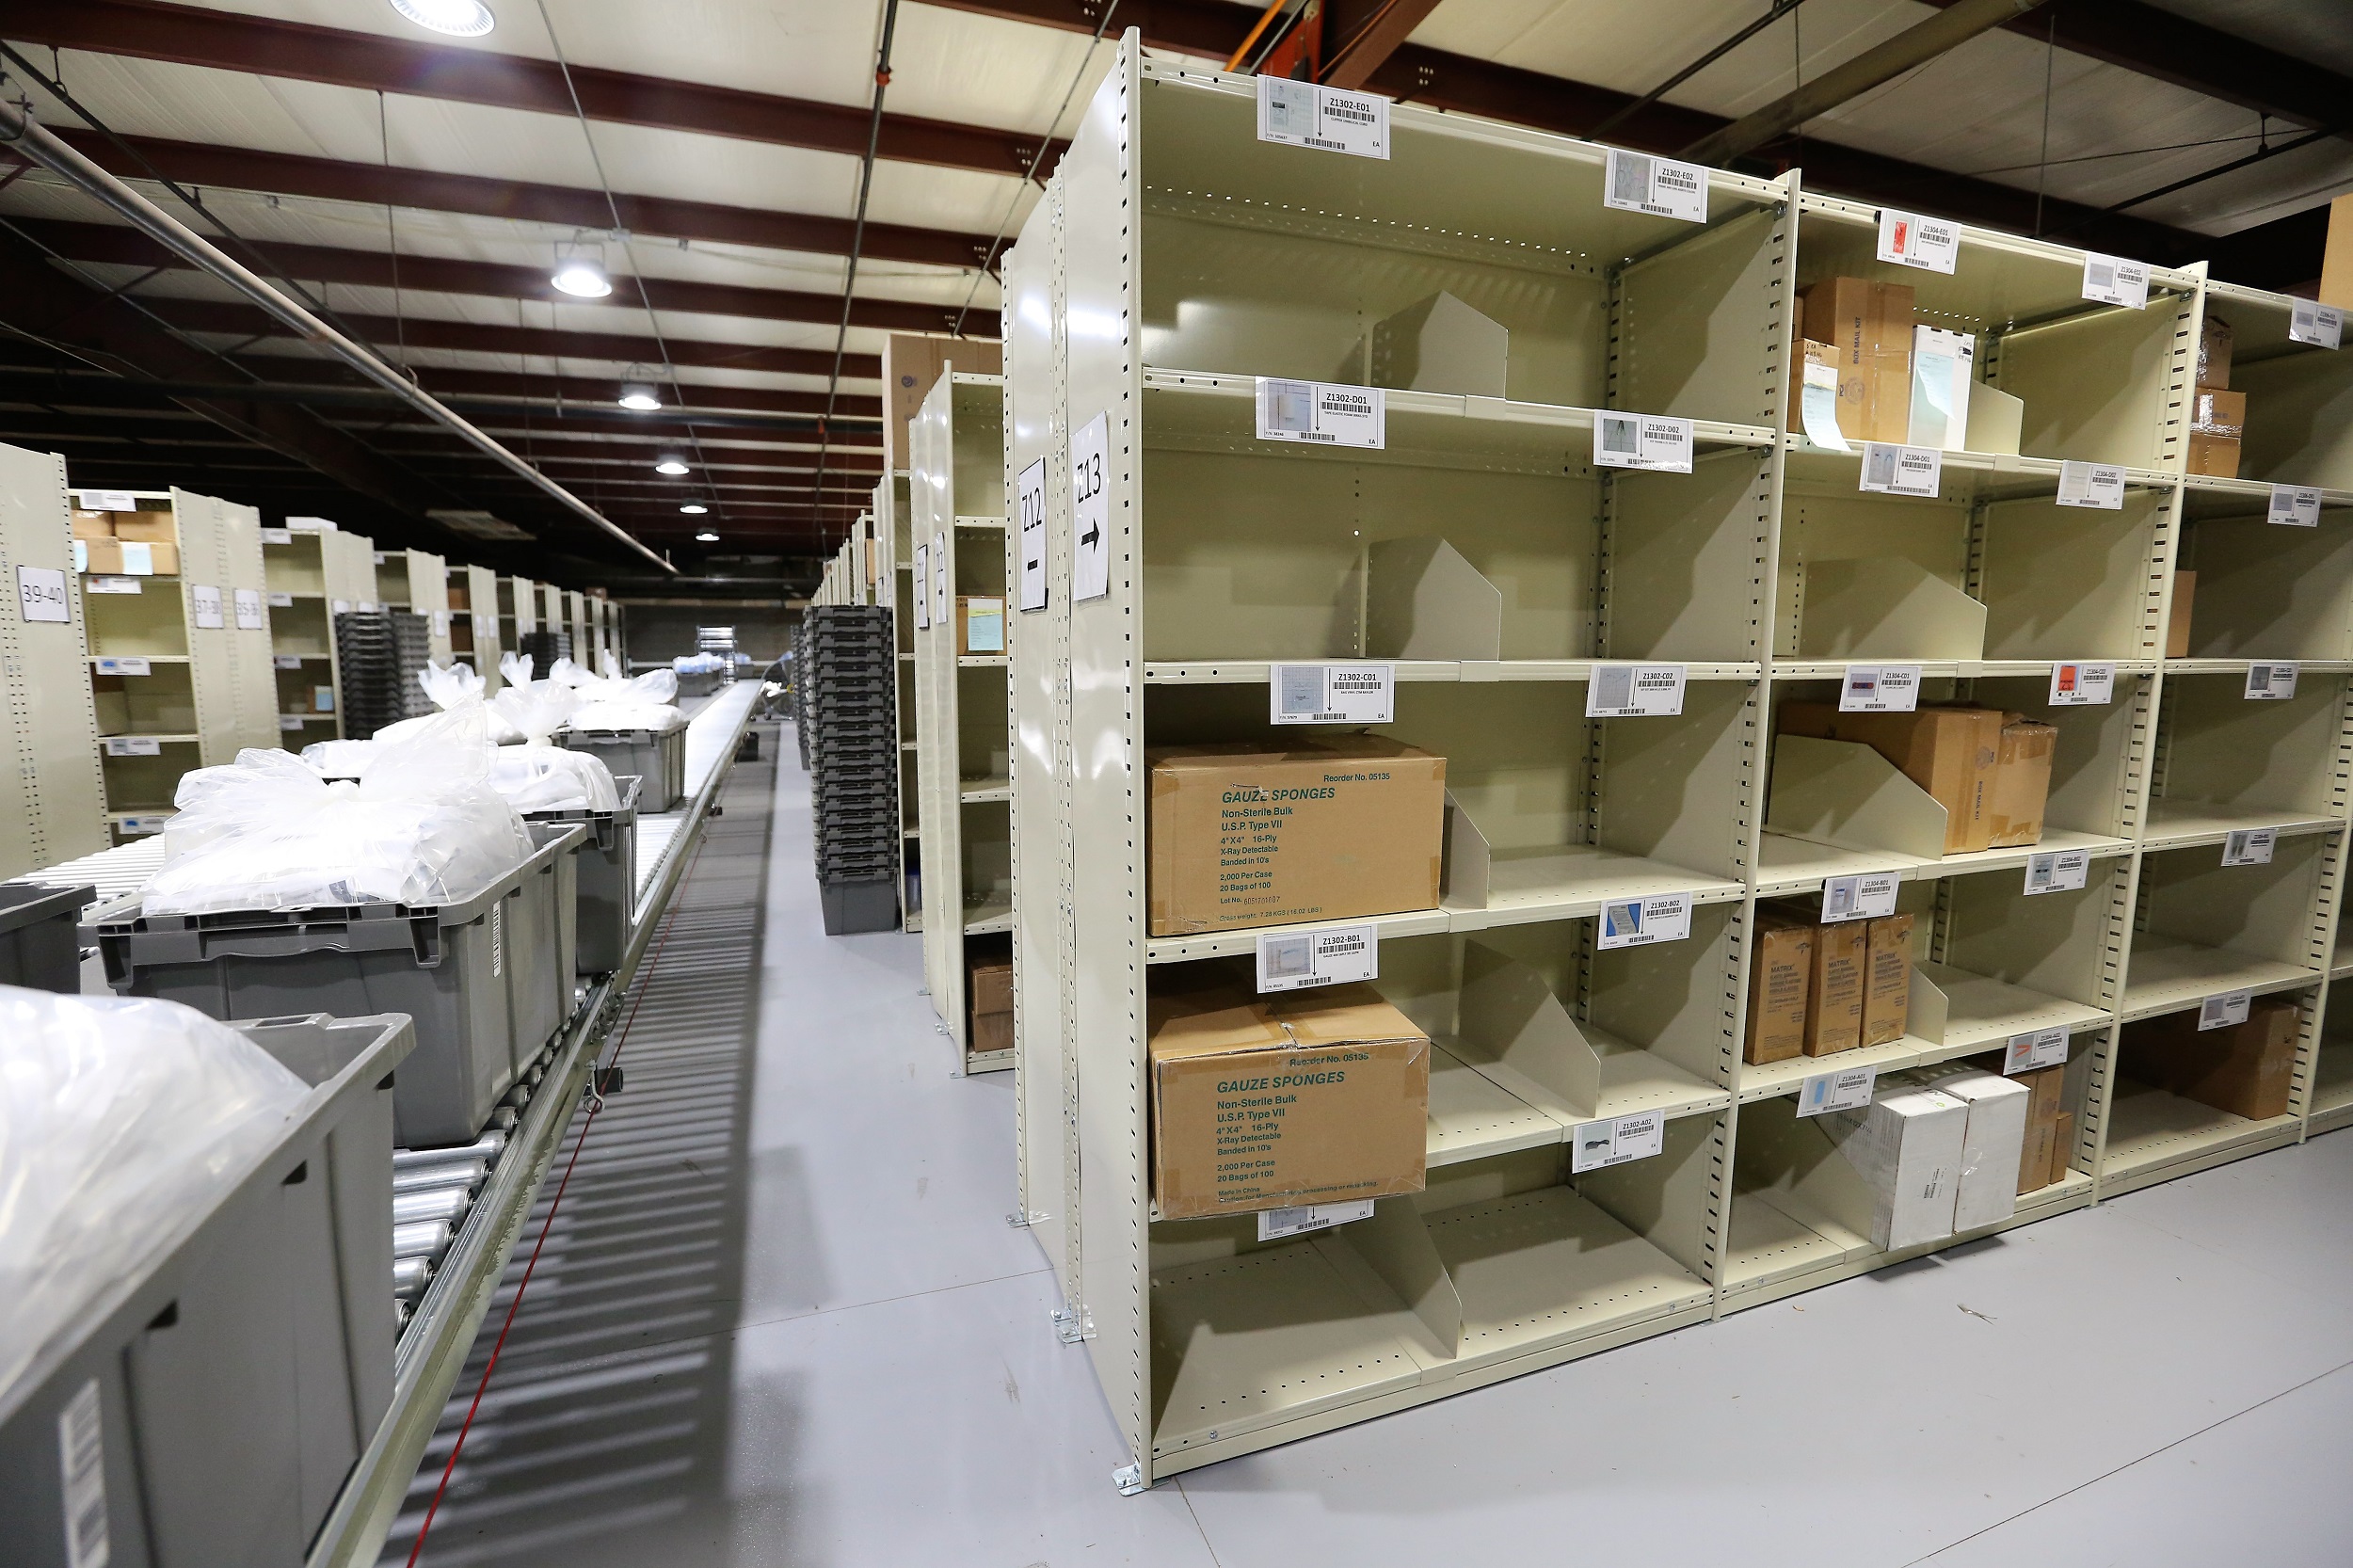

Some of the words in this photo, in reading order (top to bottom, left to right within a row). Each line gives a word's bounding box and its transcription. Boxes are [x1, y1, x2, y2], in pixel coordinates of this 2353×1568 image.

[1329, 98, 1370, 113] Z1302-E01
[1662, 168, 1694, 181] Z1302-E02
[1327, 393, 1368, 405] Z1302-D01
[1648, 424, 1679, 433] Z1302-D02
[1077, 452, 1101, 504] Z13
[1021, 487, 1043, 533] Z12
[23, 584, 64, 604] 39-40
[1323, 774, 1353, 783] Reorder
[1369, 773, 1390, 781] 05135
[1271, 787, 1335, 800] SPONGES
[1222, 808, 1272, 819] Non-Sterile
[1273, 806, 1293, 816] Bulk
[1222, 822, 1246, 832] U.S.P.
[1248, 821, 1269, 831] Type
[1271, 820, 1282, 828] VII
[1253, 835, 1277, 843] 16-Ply
[1221, 847, 1241, 856] X-Ray
[1242, 845, 1278, 854] Detectable
[1221, 857, 1247, 866] Banded
[1230, 884, 1248, 892] Bags
[1651, 900, 1679, 909] Z1302-B02
[1323, 934, 1361, 945] Z1302-B01
[1289, 1056, 1325, 1066] Reorder
[1327, 1055, 1341, 1064] No.
[1343, 1052, 1369, 1062] 05135
[1217, 1078, 1269, 1094] GAUZE
[1273, 1071, 1345, 1089] SPONGES
[1218, 1096, 1273, 1110] Non-Sterile
[1275, 1095, 1297, 1104] Bulk
[1218, 1112, 1244, 1123] U.S.P.
[1247, 1110, 1271, 1121] Type
[1273, 1108, 1285, 1116] VII
[1252, 1122, 1279, 1132] 16-Ply
[1623, 1119, 1651, 1129] Z1302-A02
[1217, 1137, 1240, 1145] X-Ray
[1241, 1132, 1281, 1143] Detectable
[1218, 1146, 1246, 1156] Banded
[1217, 1163, 1239, 1172] 2,000
[1229, 1173, 1249, 1182] Bags
[1303, 1186, 1337, 1194] processing
